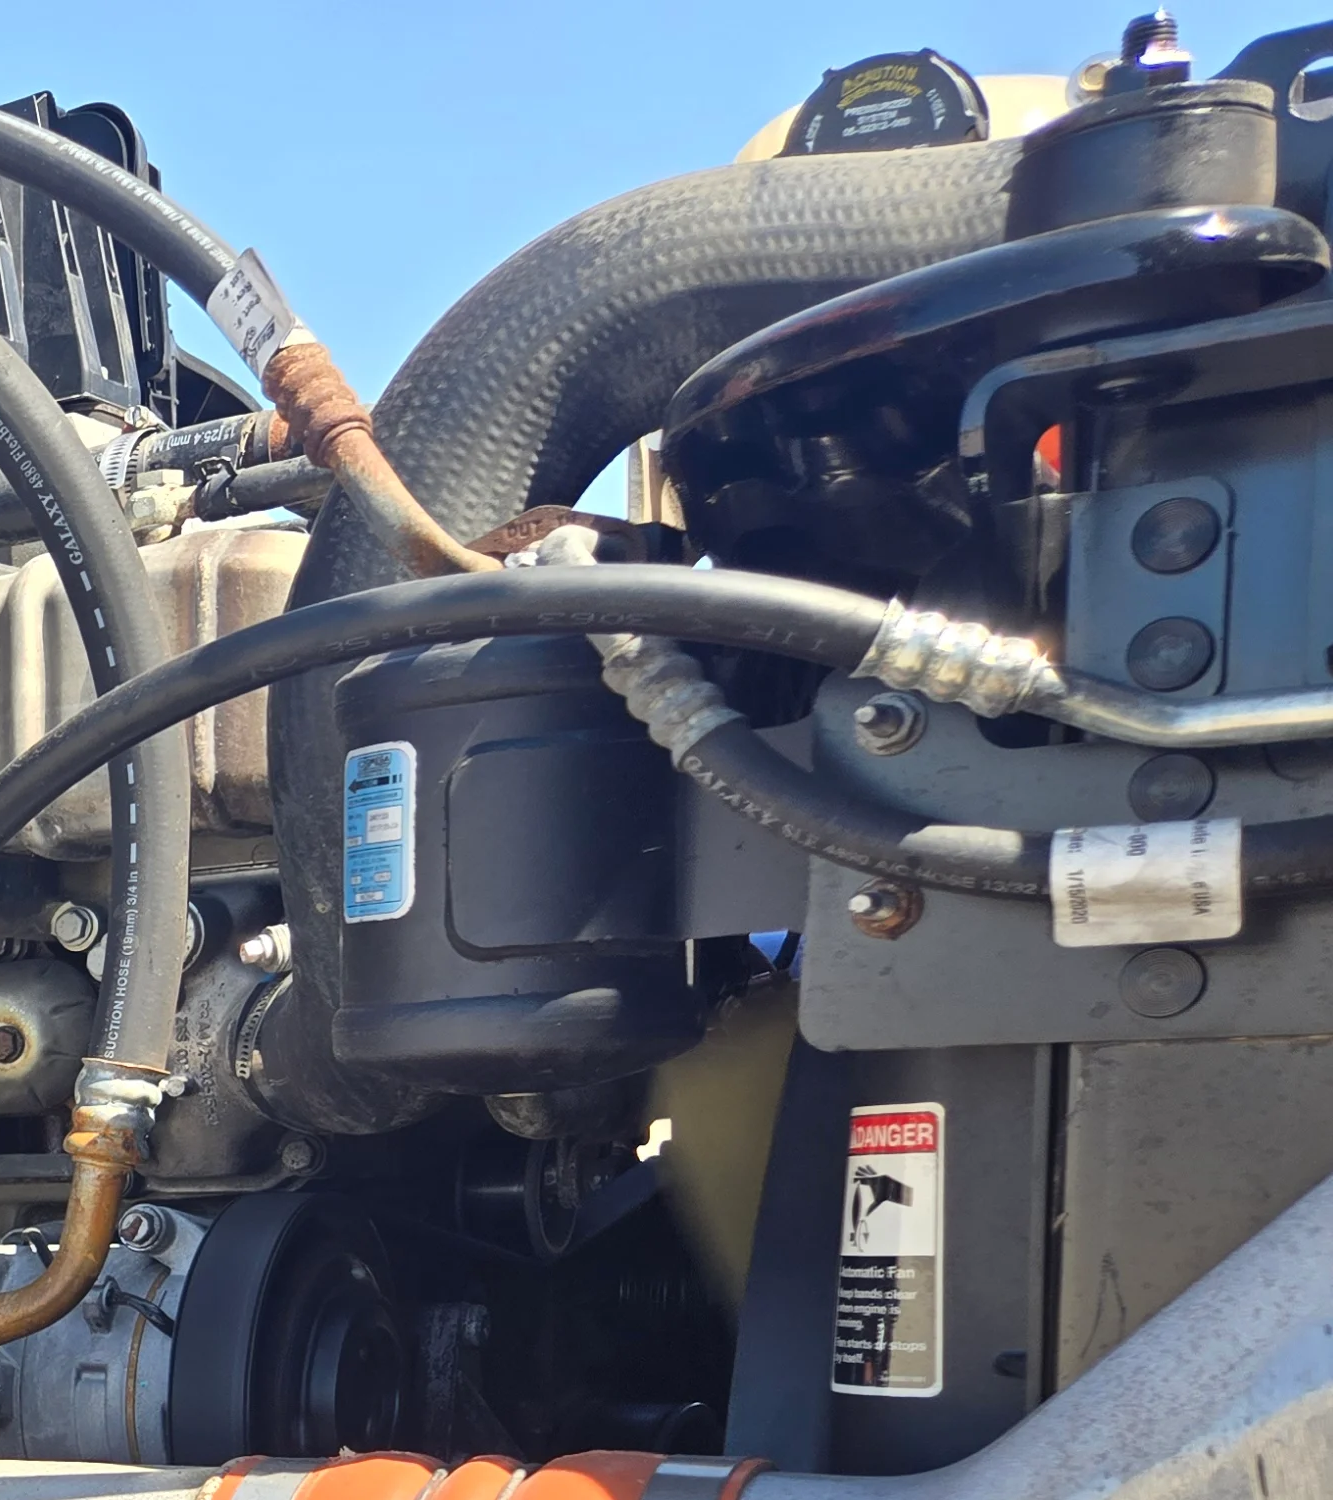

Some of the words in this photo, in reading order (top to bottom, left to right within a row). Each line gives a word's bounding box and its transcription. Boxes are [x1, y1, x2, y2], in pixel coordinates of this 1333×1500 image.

[18, 459, 44, 491] 4880
[37, 492, 83, 566] GALAXY
[914, 867, 976, 890] HOSE
[126, 886, 139, 906] 3/4
[121, 908, 139, 956] (19mm)
[115, 958, 131, 997] HOSE
[104, 1000, 125, 1059] SUCTION
[854, 1122, 934, 1147] DANGER
[886, 1265, 916, 1279] Fan
